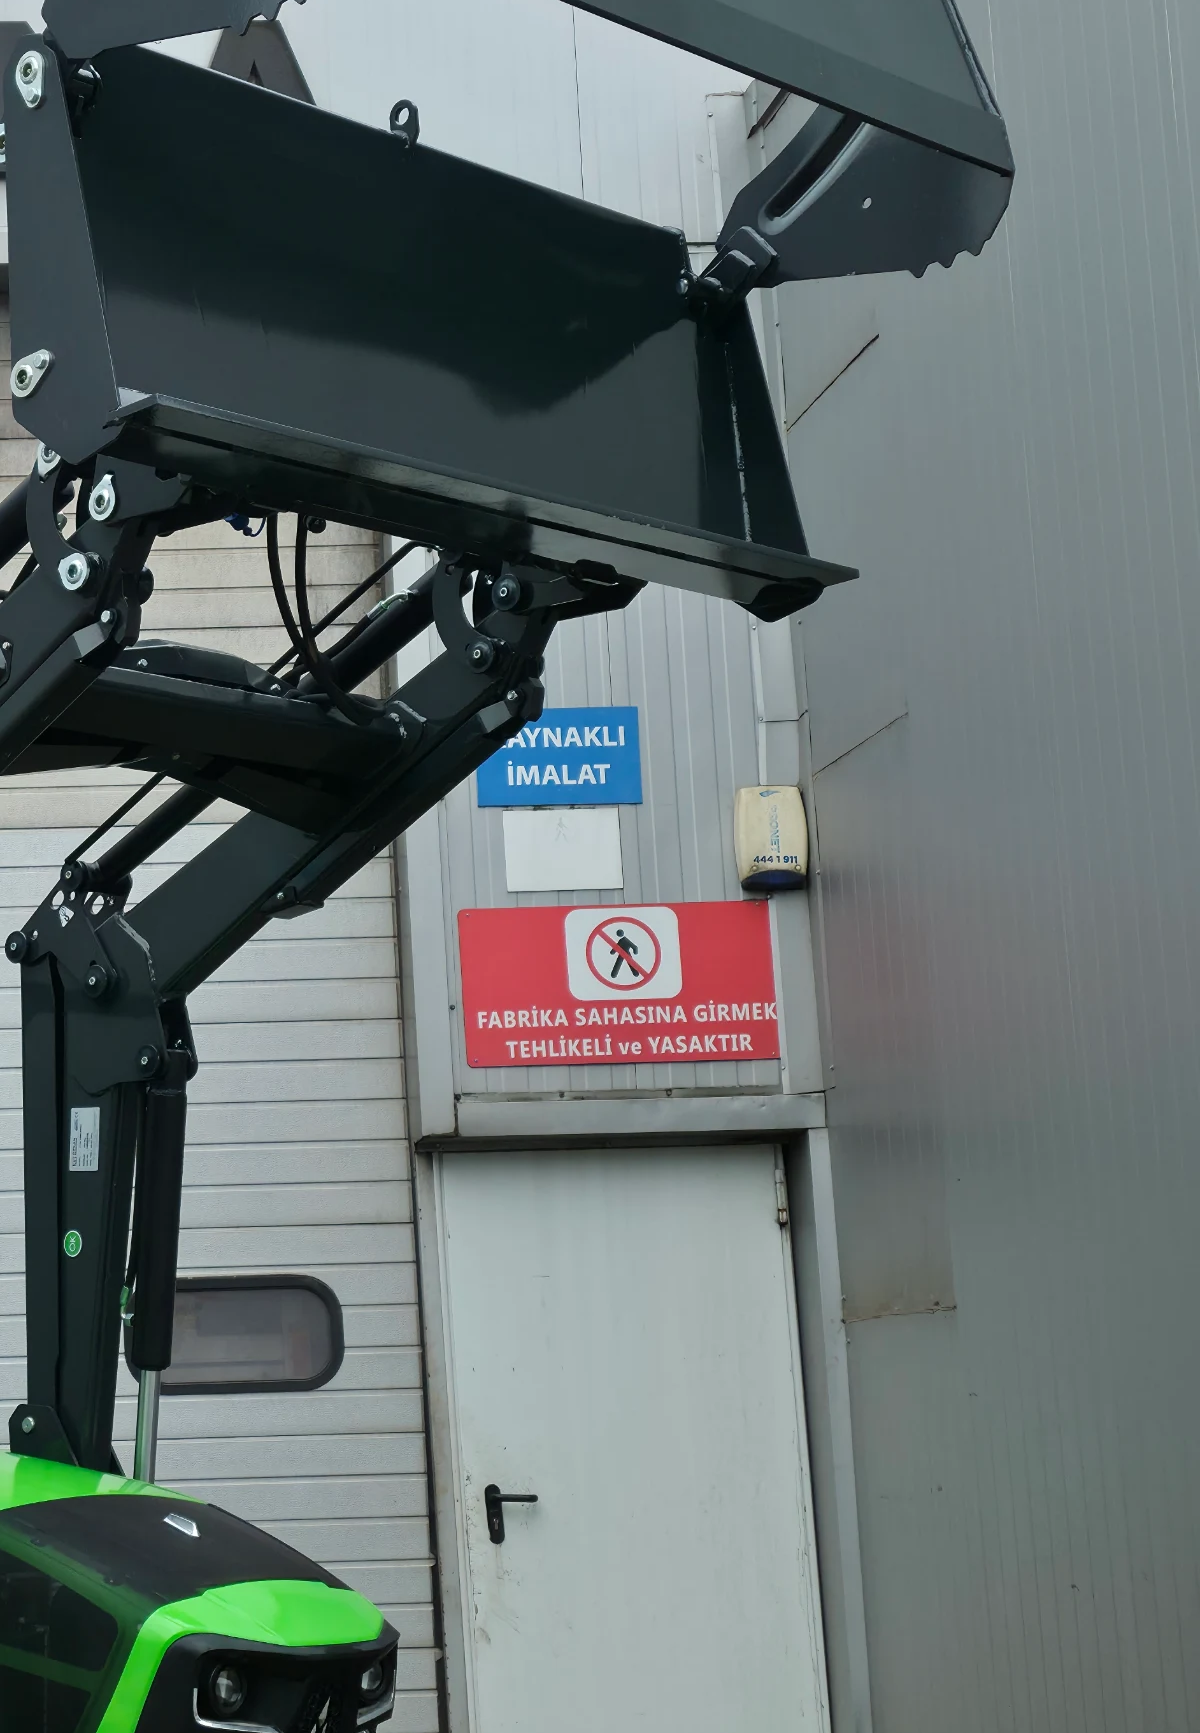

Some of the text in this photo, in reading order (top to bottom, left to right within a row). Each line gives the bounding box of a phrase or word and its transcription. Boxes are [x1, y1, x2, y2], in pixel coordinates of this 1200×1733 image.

[500, 724, 626, 748] AYNAKLI
[507, 761, 611, 786] İMALAT
[753, 855, 774, 864] 444
[783, 855, 798, 864] 911
[477, 999, 778, 1030] FABRİKA SAHASINA GİRMEK
[505, 1033, 754, 1060] TEHLİKELİ ve YASAKTIR
[69, 1235, 76, 1251] OK
